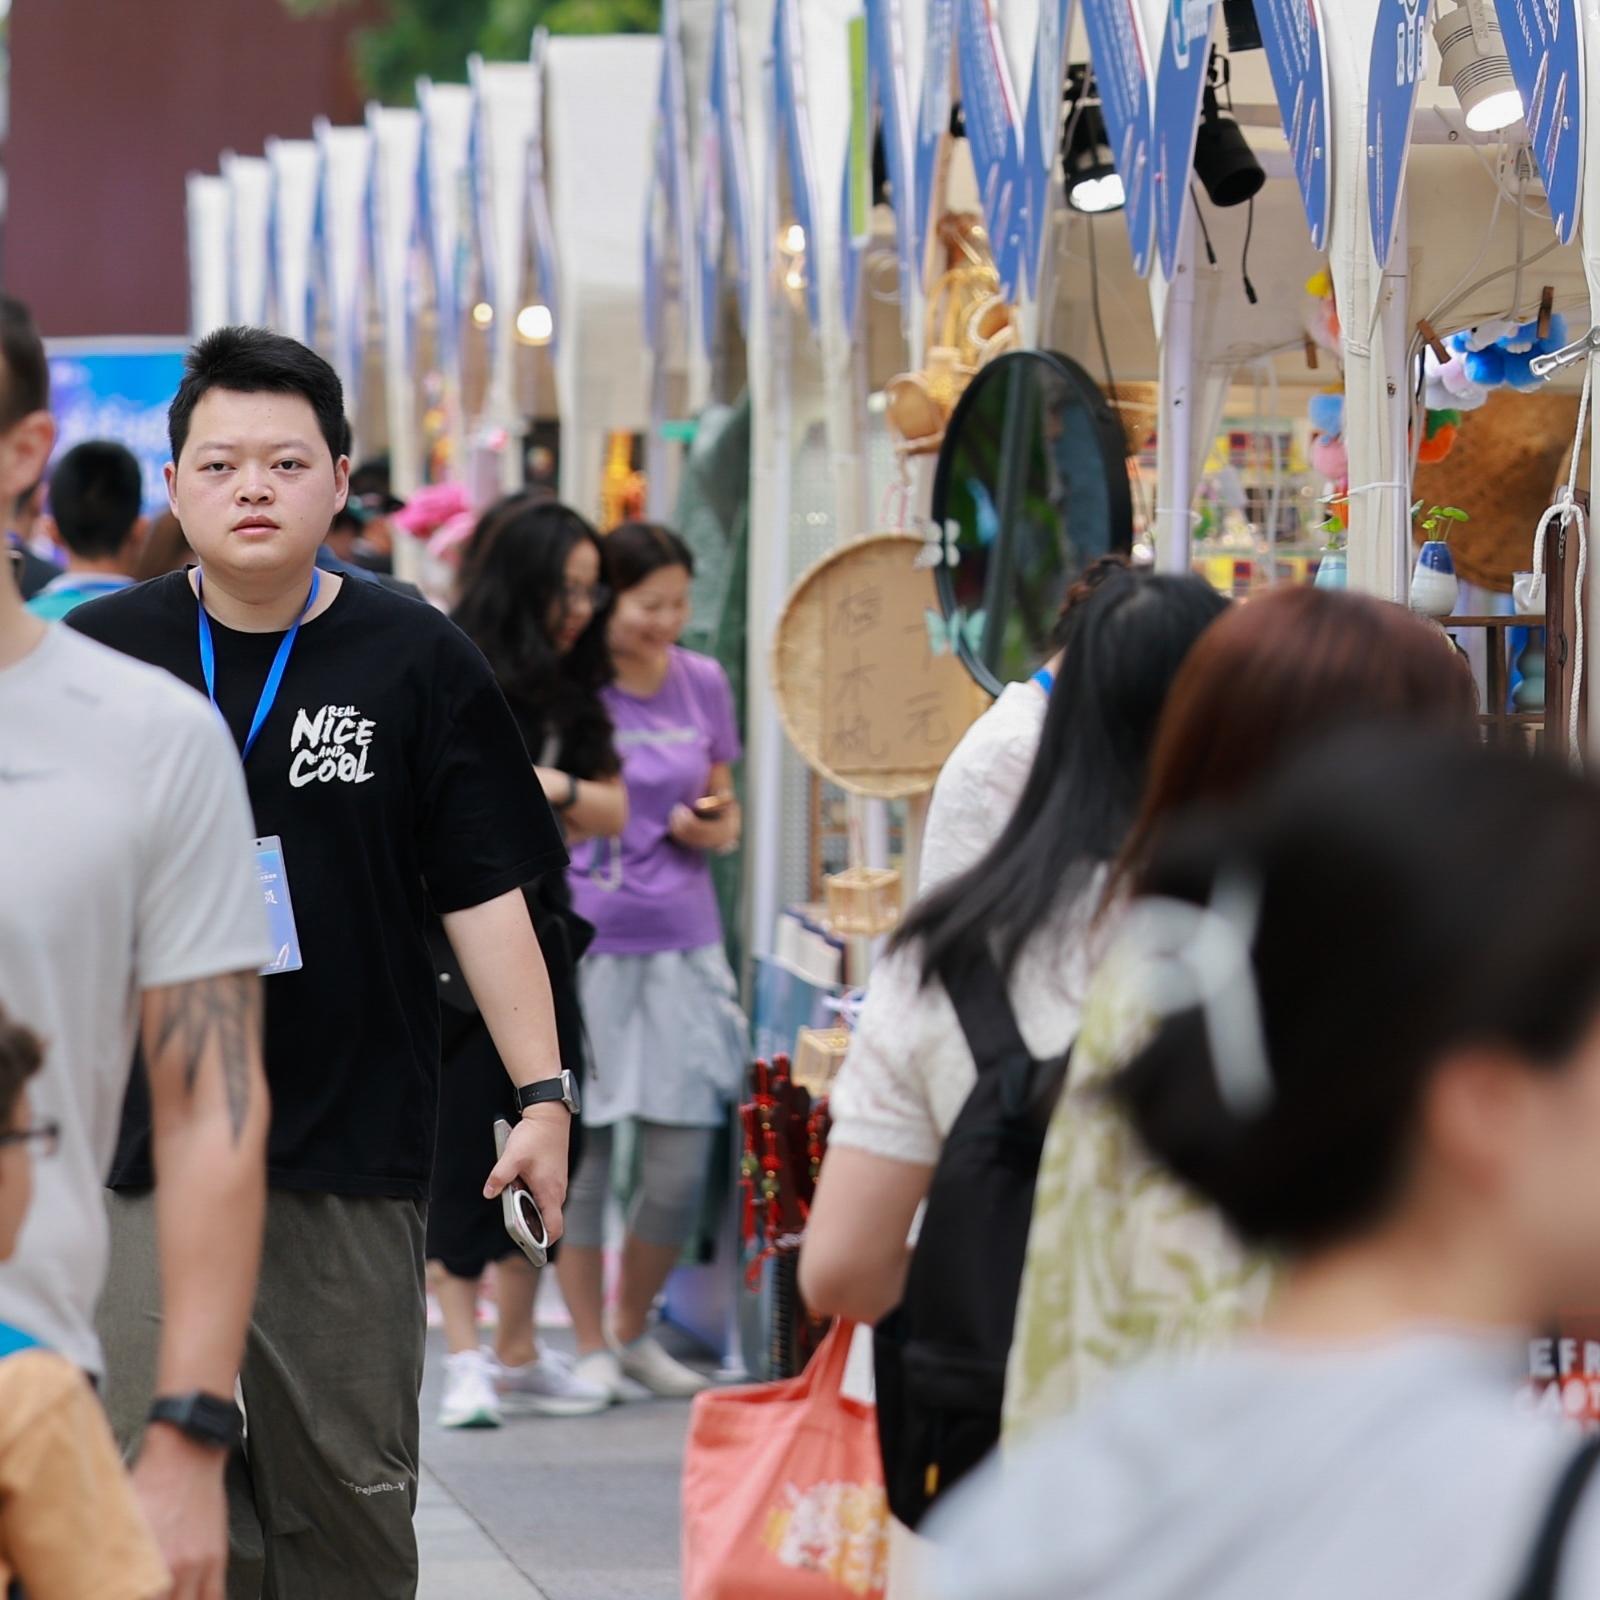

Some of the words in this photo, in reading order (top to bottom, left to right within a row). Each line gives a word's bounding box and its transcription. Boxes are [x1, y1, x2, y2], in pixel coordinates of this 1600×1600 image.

[327, 704, 361, 718] REAL
[290, 705, 377, 752] NICE
[318, 744, 346, 759] AND
[289, 745, 376, 788] COOL
